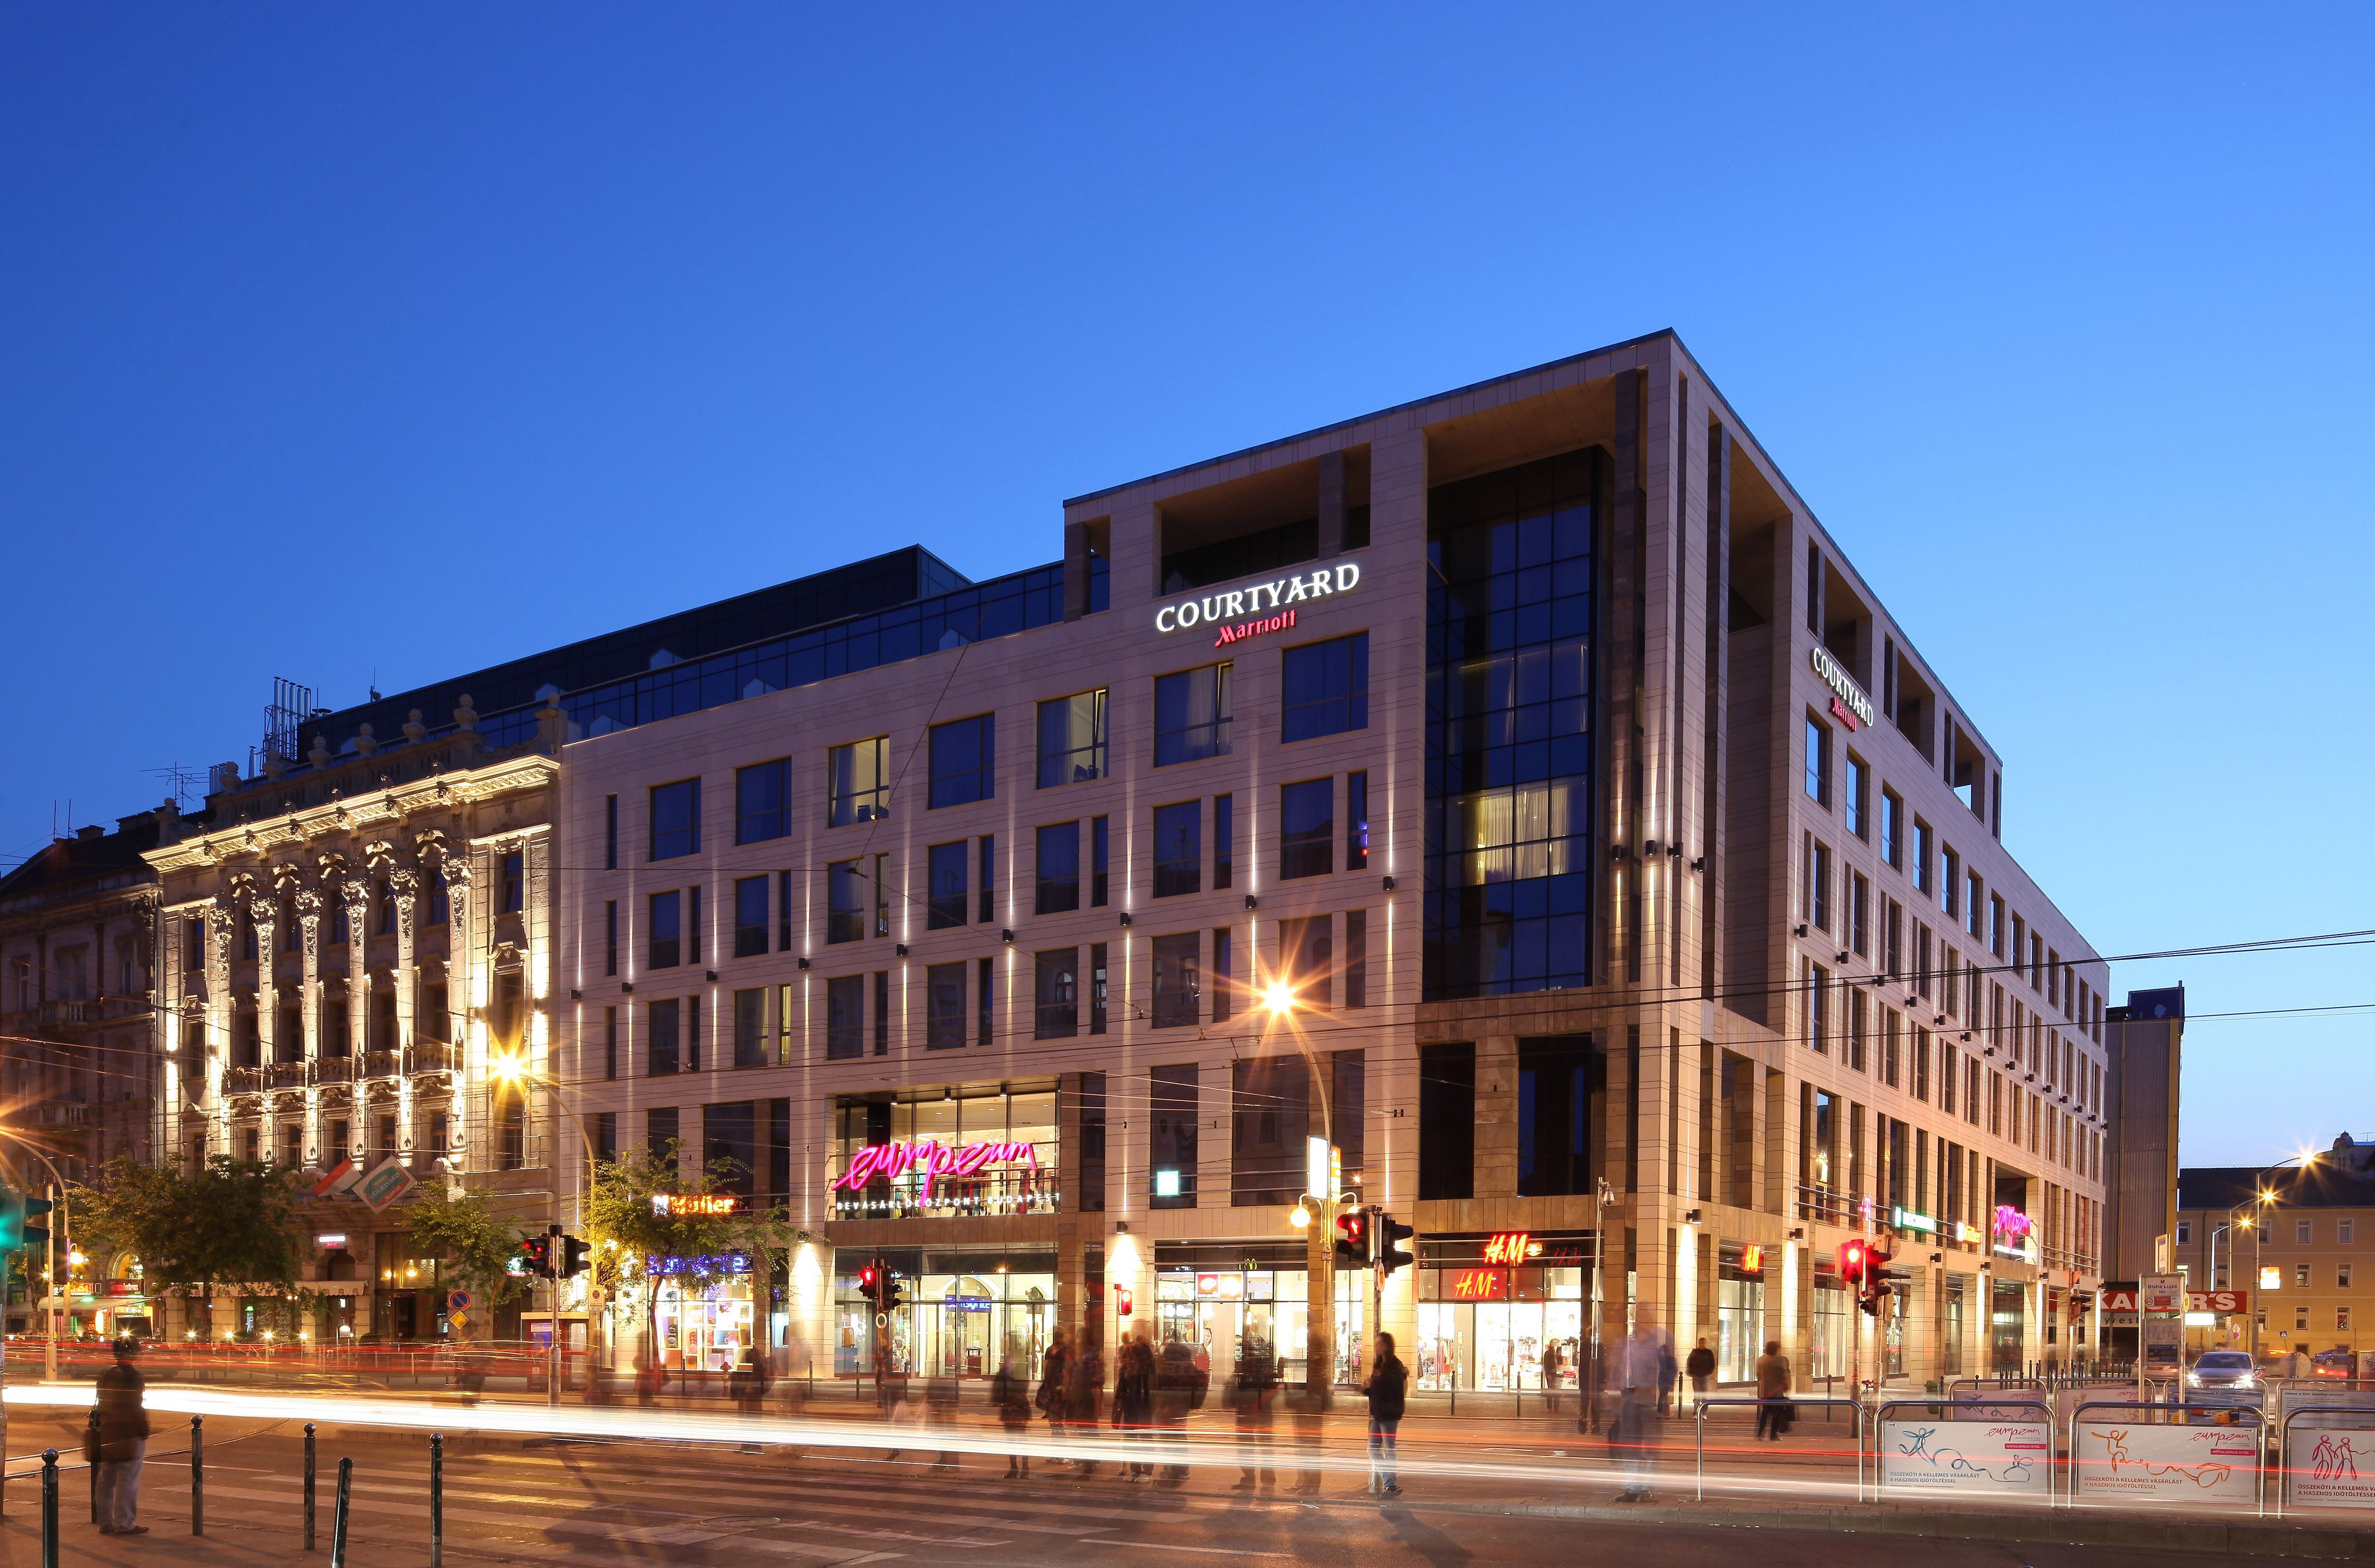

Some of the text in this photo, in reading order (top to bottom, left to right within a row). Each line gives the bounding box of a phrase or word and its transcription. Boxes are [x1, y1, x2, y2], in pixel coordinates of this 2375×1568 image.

[1155, 563, 1361, 633] COURTYARD
[1214, 609, 1298, 648] Marriott
[1811, 647, 1874, 728] COURTYARD
[1829, 697, 1857, 732] Marriott
[370, 1172, 400, 1199] COURTYARD
[987, 1193, 1060, 1204] BUDAPEST
[1484, 1234, 1528, 1264] H&M
[1455, 1272, 1493, 1298] H&M
